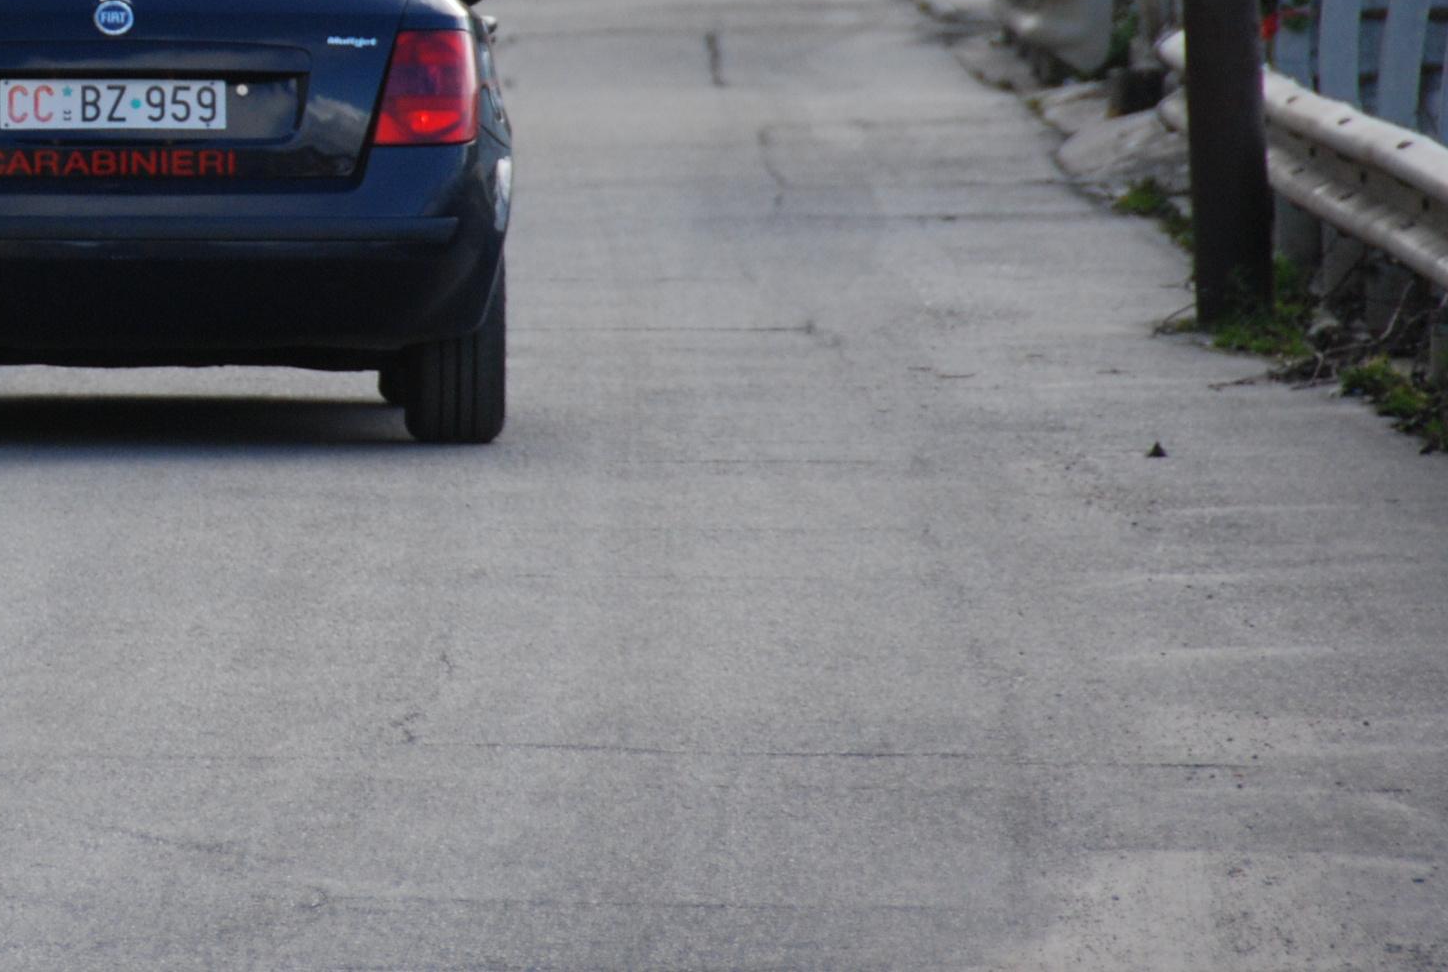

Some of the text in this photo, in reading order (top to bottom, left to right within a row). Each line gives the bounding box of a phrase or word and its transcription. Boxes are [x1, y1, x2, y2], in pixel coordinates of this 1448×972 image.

[100, 11, 126, 24] FIAT
[7, 85, 217, 123] CC BZ 959
